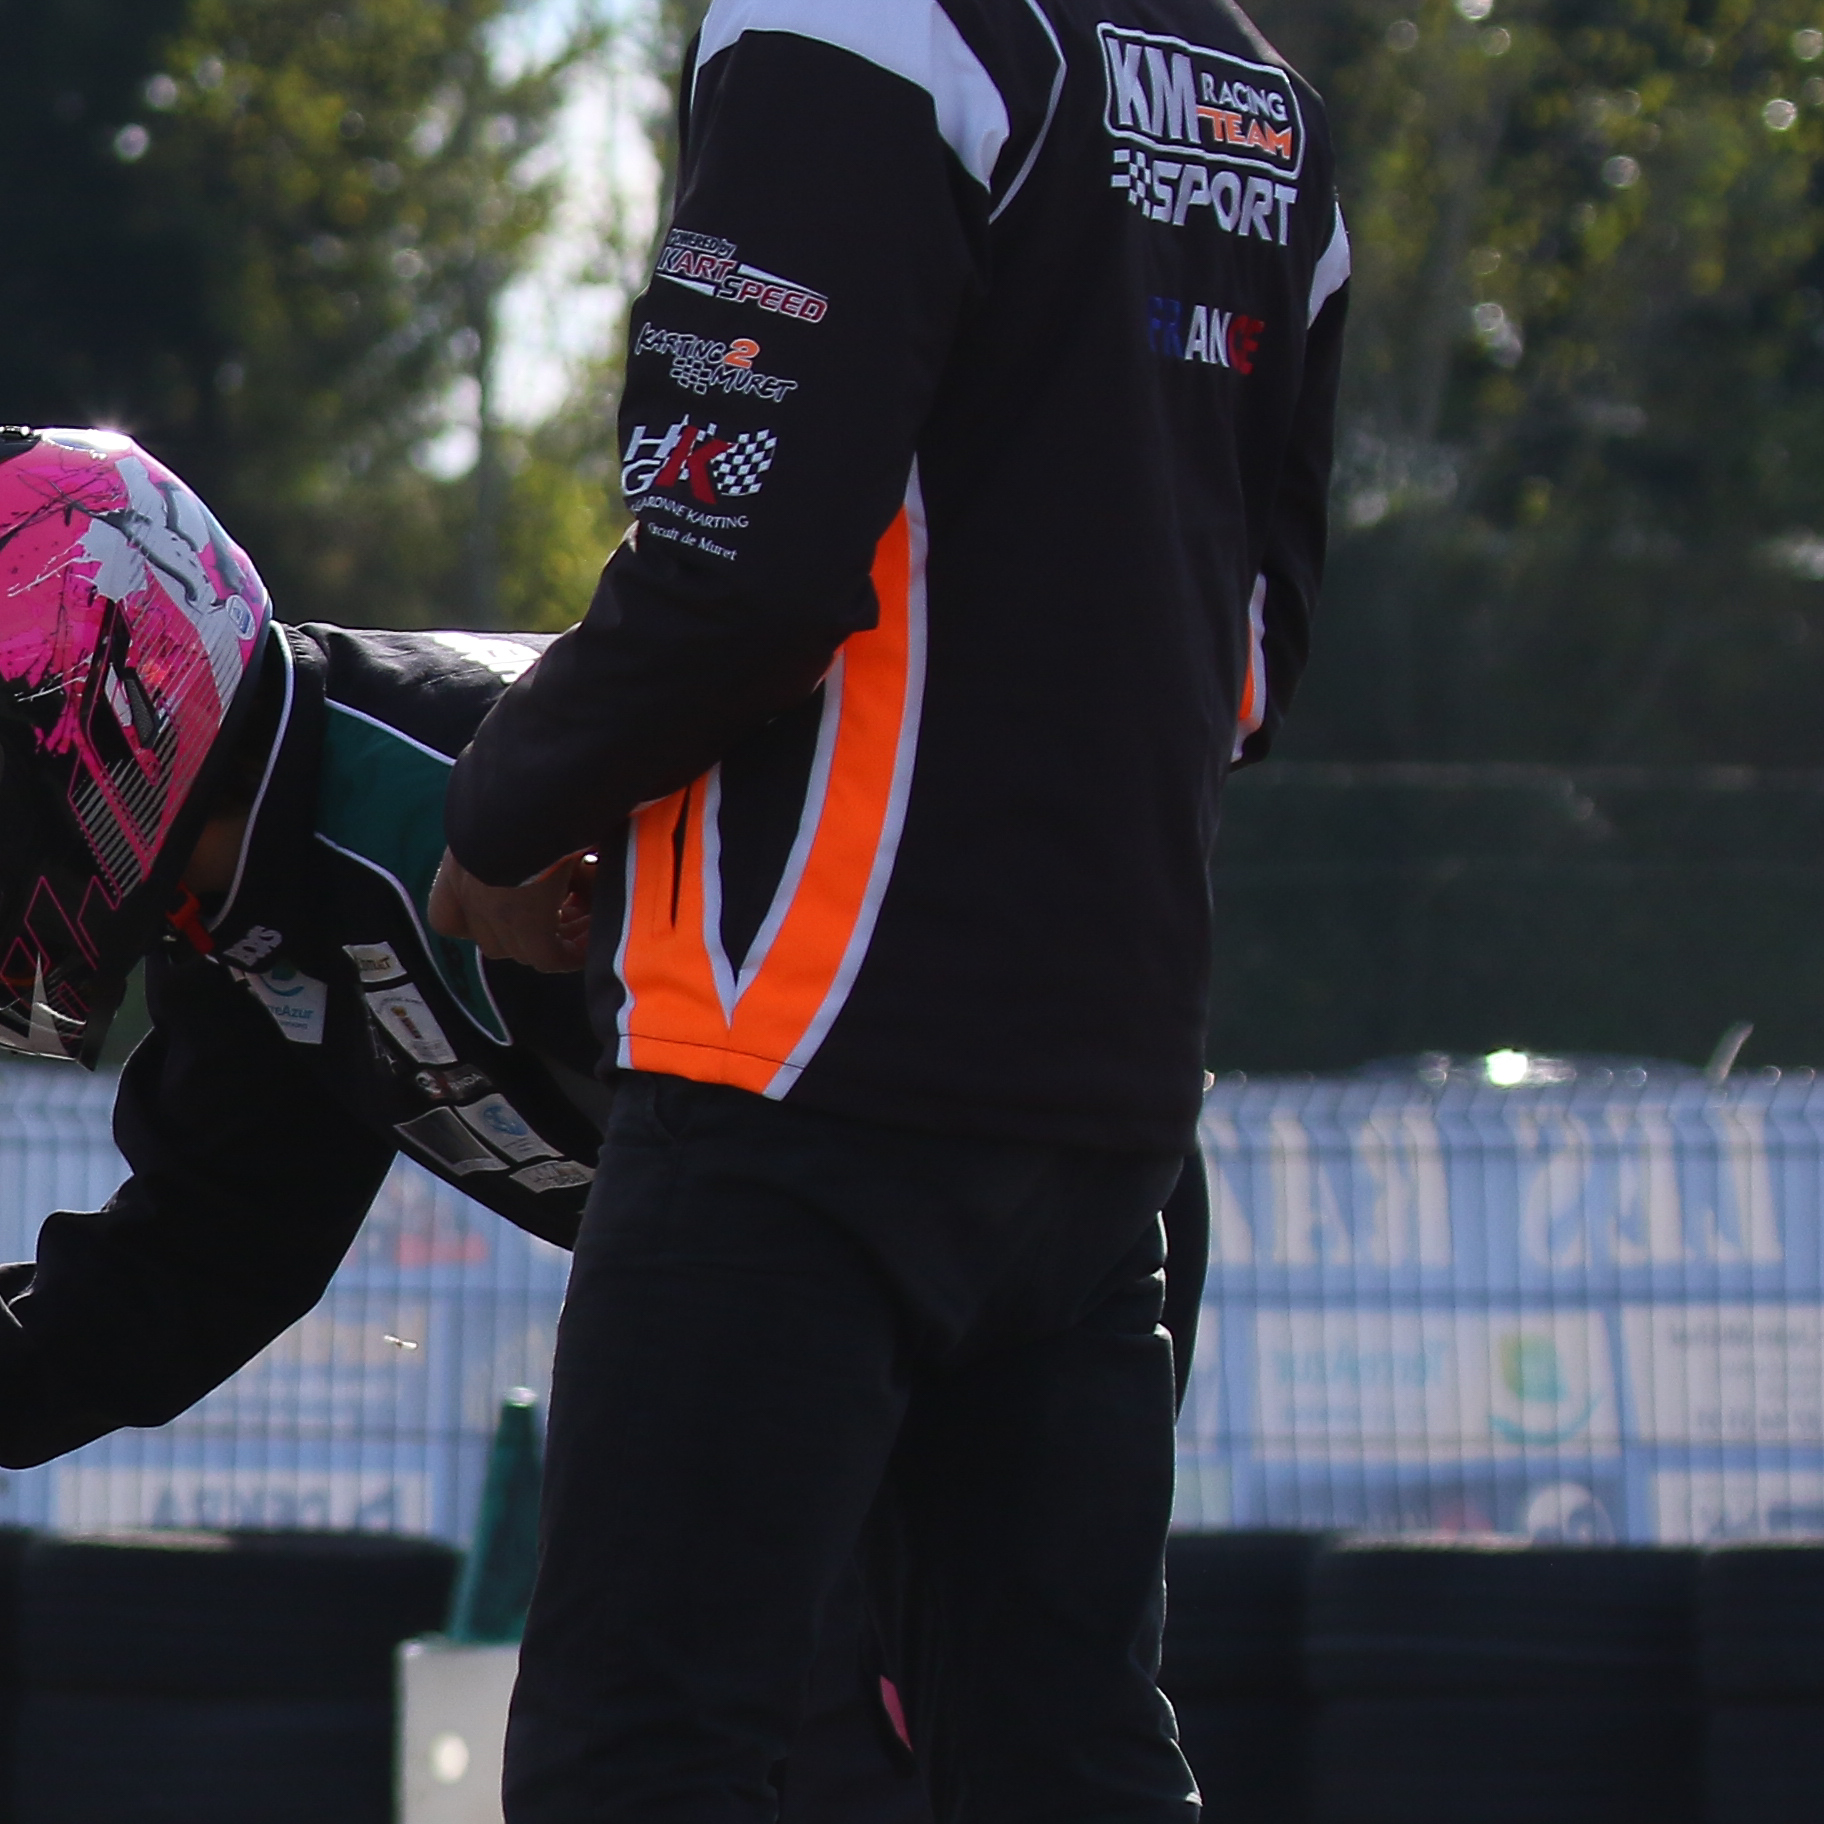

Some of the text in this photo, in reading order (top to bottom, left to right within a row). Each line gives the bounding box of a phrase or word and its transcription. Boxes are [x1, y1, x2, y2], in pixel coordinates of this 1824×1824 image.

[1105, 36, 1202, 145] KM
[1201, 72, 1289, 122] RACING
[1196, 105, 1293, 161] TEAM
[1150, 159, 1298, 246] SPORT
[657, 246, 738, 282] KART
[716, 274, 828, 324] SPEED
[634, 322, 761, 370] KARTING 2
[1148, 295, 1266, 376] FRANCE
[709, 364, 799, 403] MURET
[686, 510, 750, 529] KARTING
[681, 531, 698, 547] de
[698, 536, 738, 561] Muret
